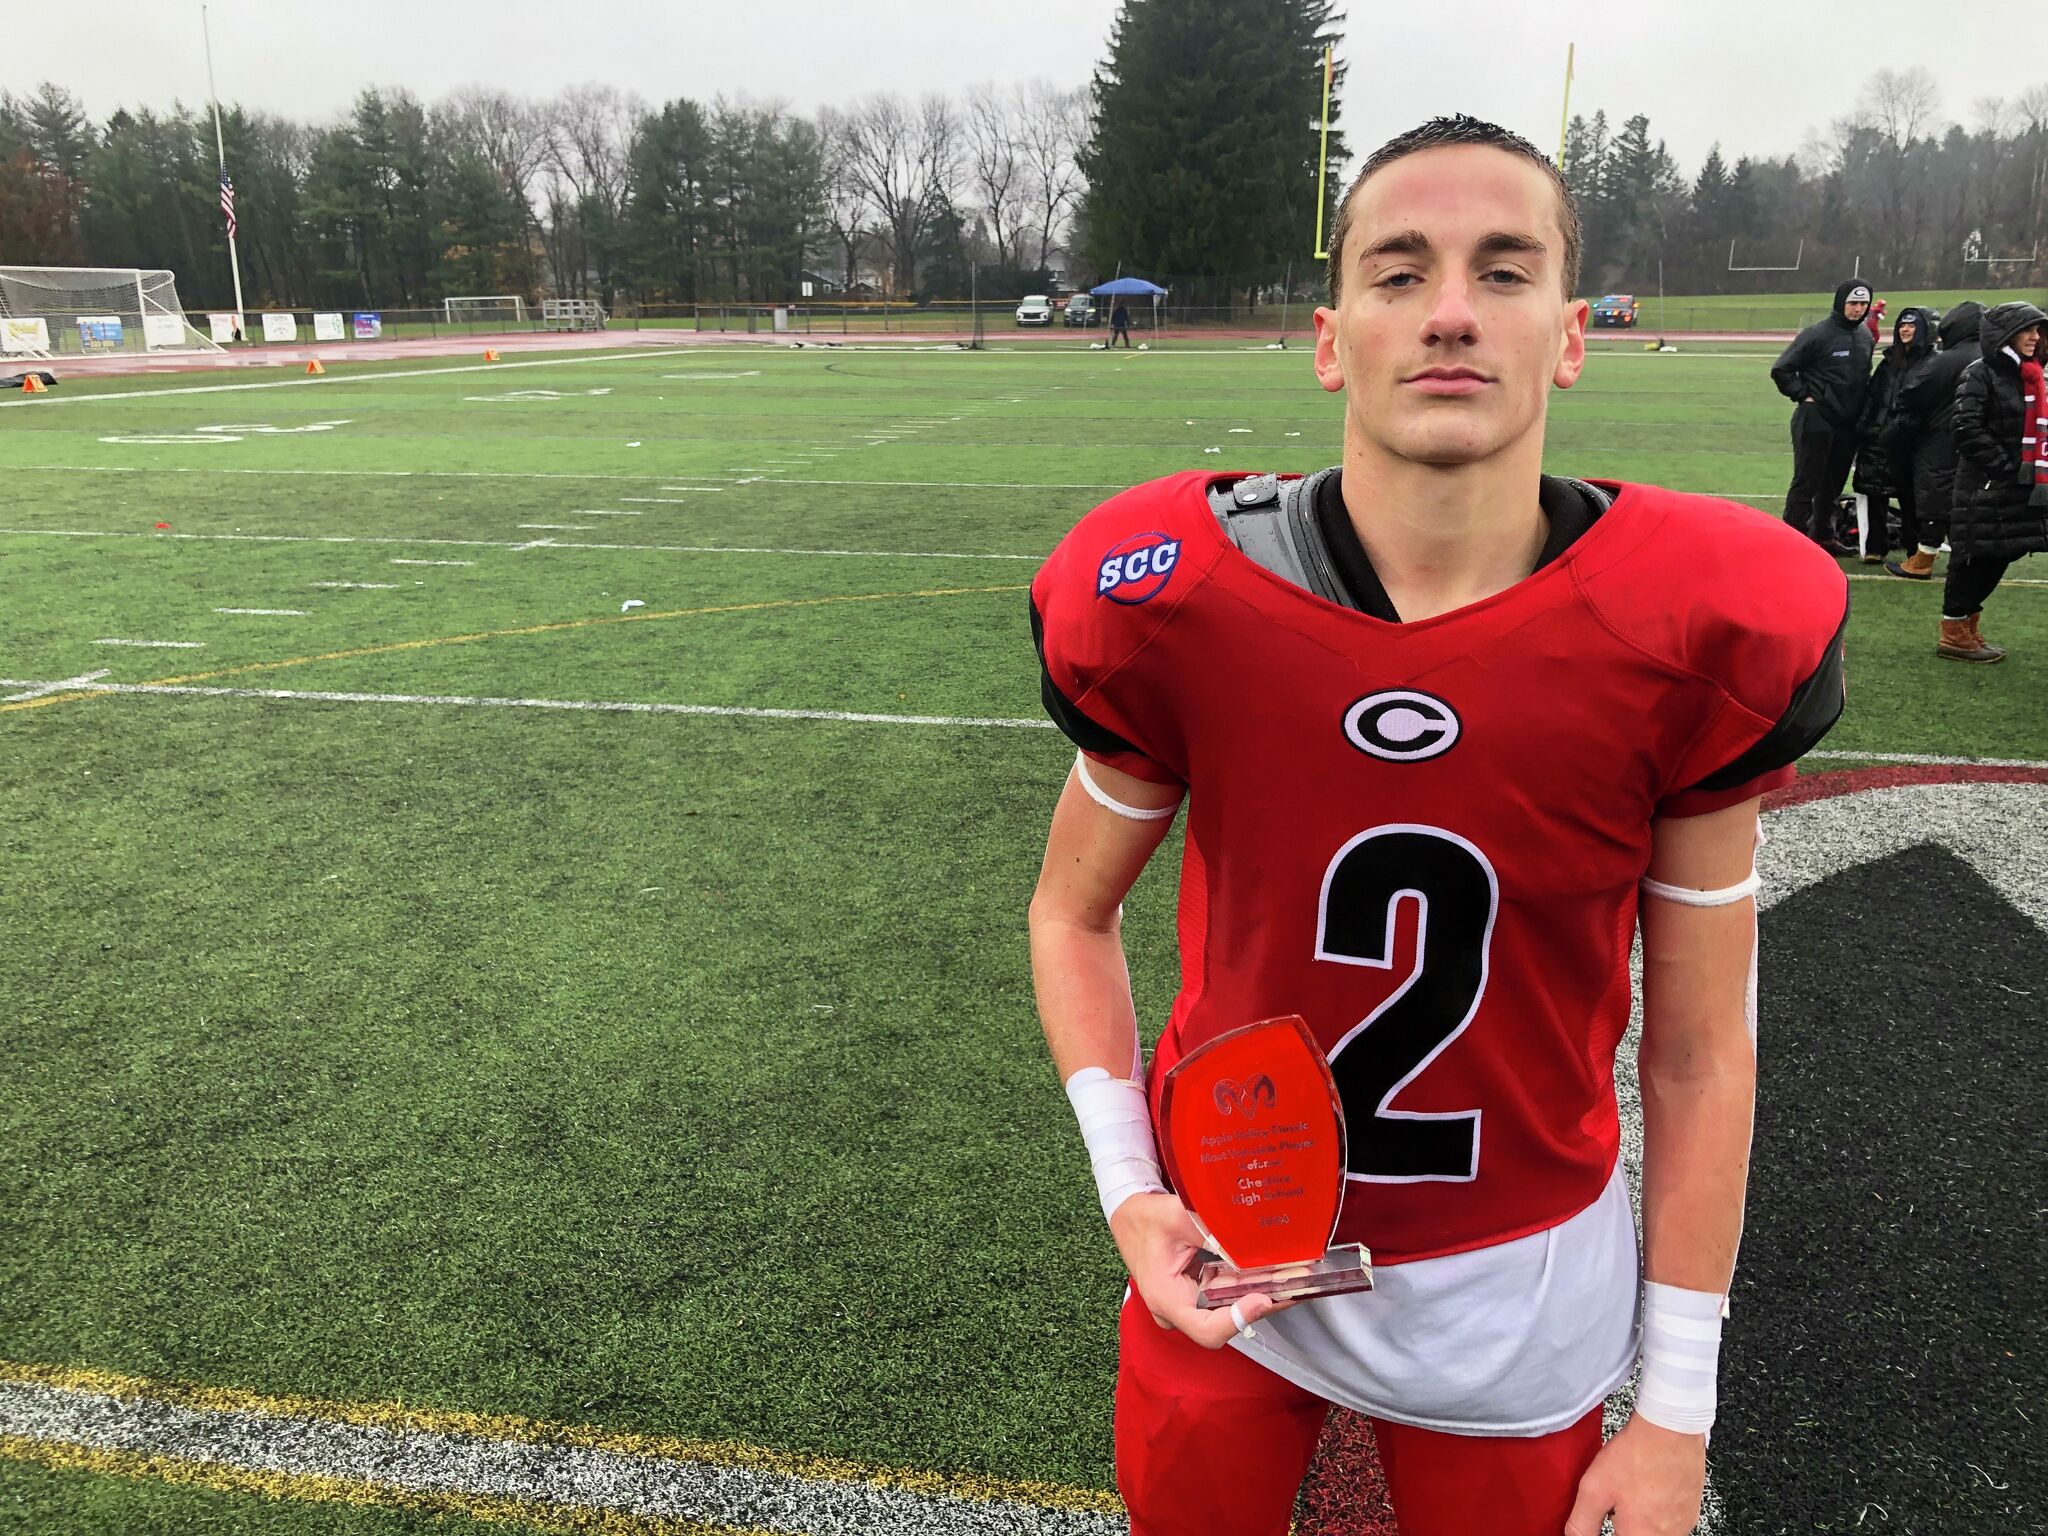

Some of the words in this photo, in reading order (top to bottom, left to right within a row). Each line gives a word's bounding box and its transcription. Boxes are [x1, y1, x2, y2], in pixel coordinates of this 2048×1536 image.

[1099, 541, 1179, 592] SCC
[1350, 695, 1453, 756] C
[1314, 823, 1500, 1184] 2
[1200, 1132, 1232, 1147] Apple
[1200, 1151, 1228, 1164] Most
[1231, 1191, 1261, 1207] High
